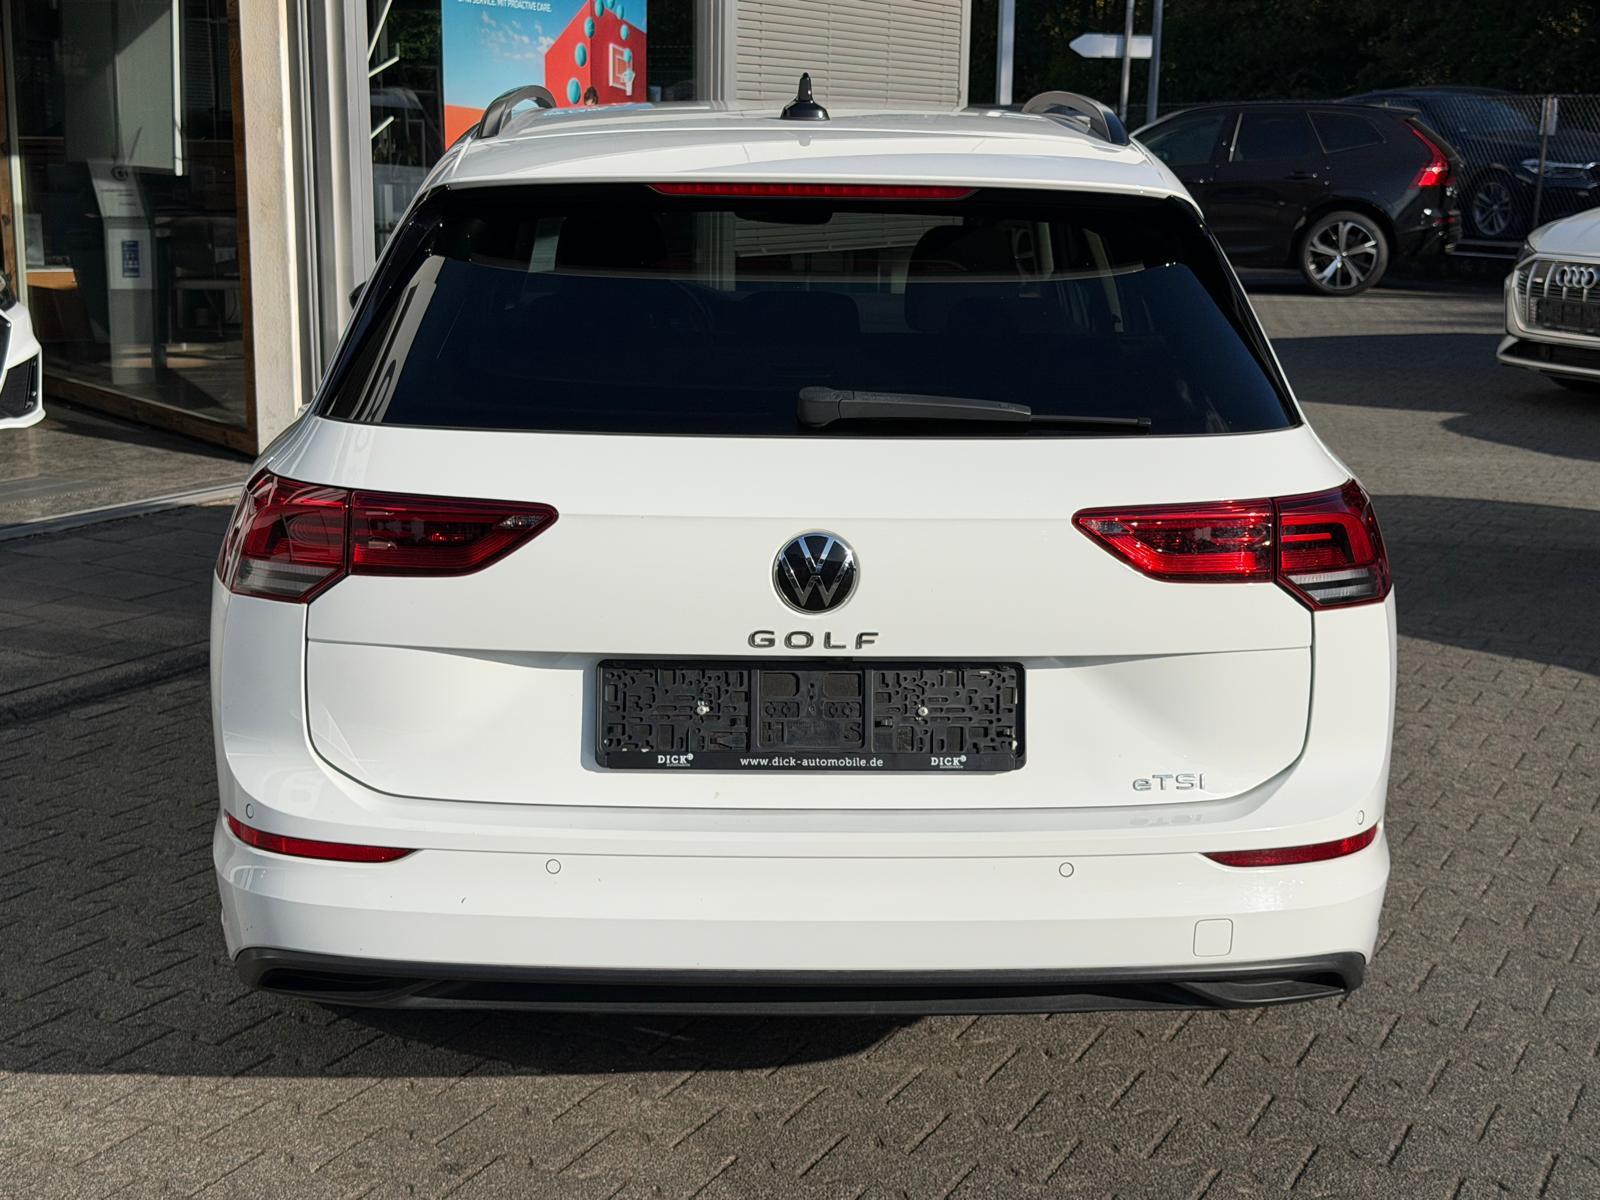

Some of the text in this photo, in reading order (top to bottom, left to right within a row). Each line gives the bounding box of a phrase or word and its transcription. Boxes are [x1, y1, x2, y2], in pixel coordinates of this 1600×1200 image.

[507, 0, 537, 11] PROACTIVE
[747, 630, 879, 650] GOLF
[657, 755, 688, 764] DICK
[740, 756, 884, 767] www.dick-automobile.de
[930, 757, 961, 766] DICK
[1132, 773, 1205, 792] eTSI
